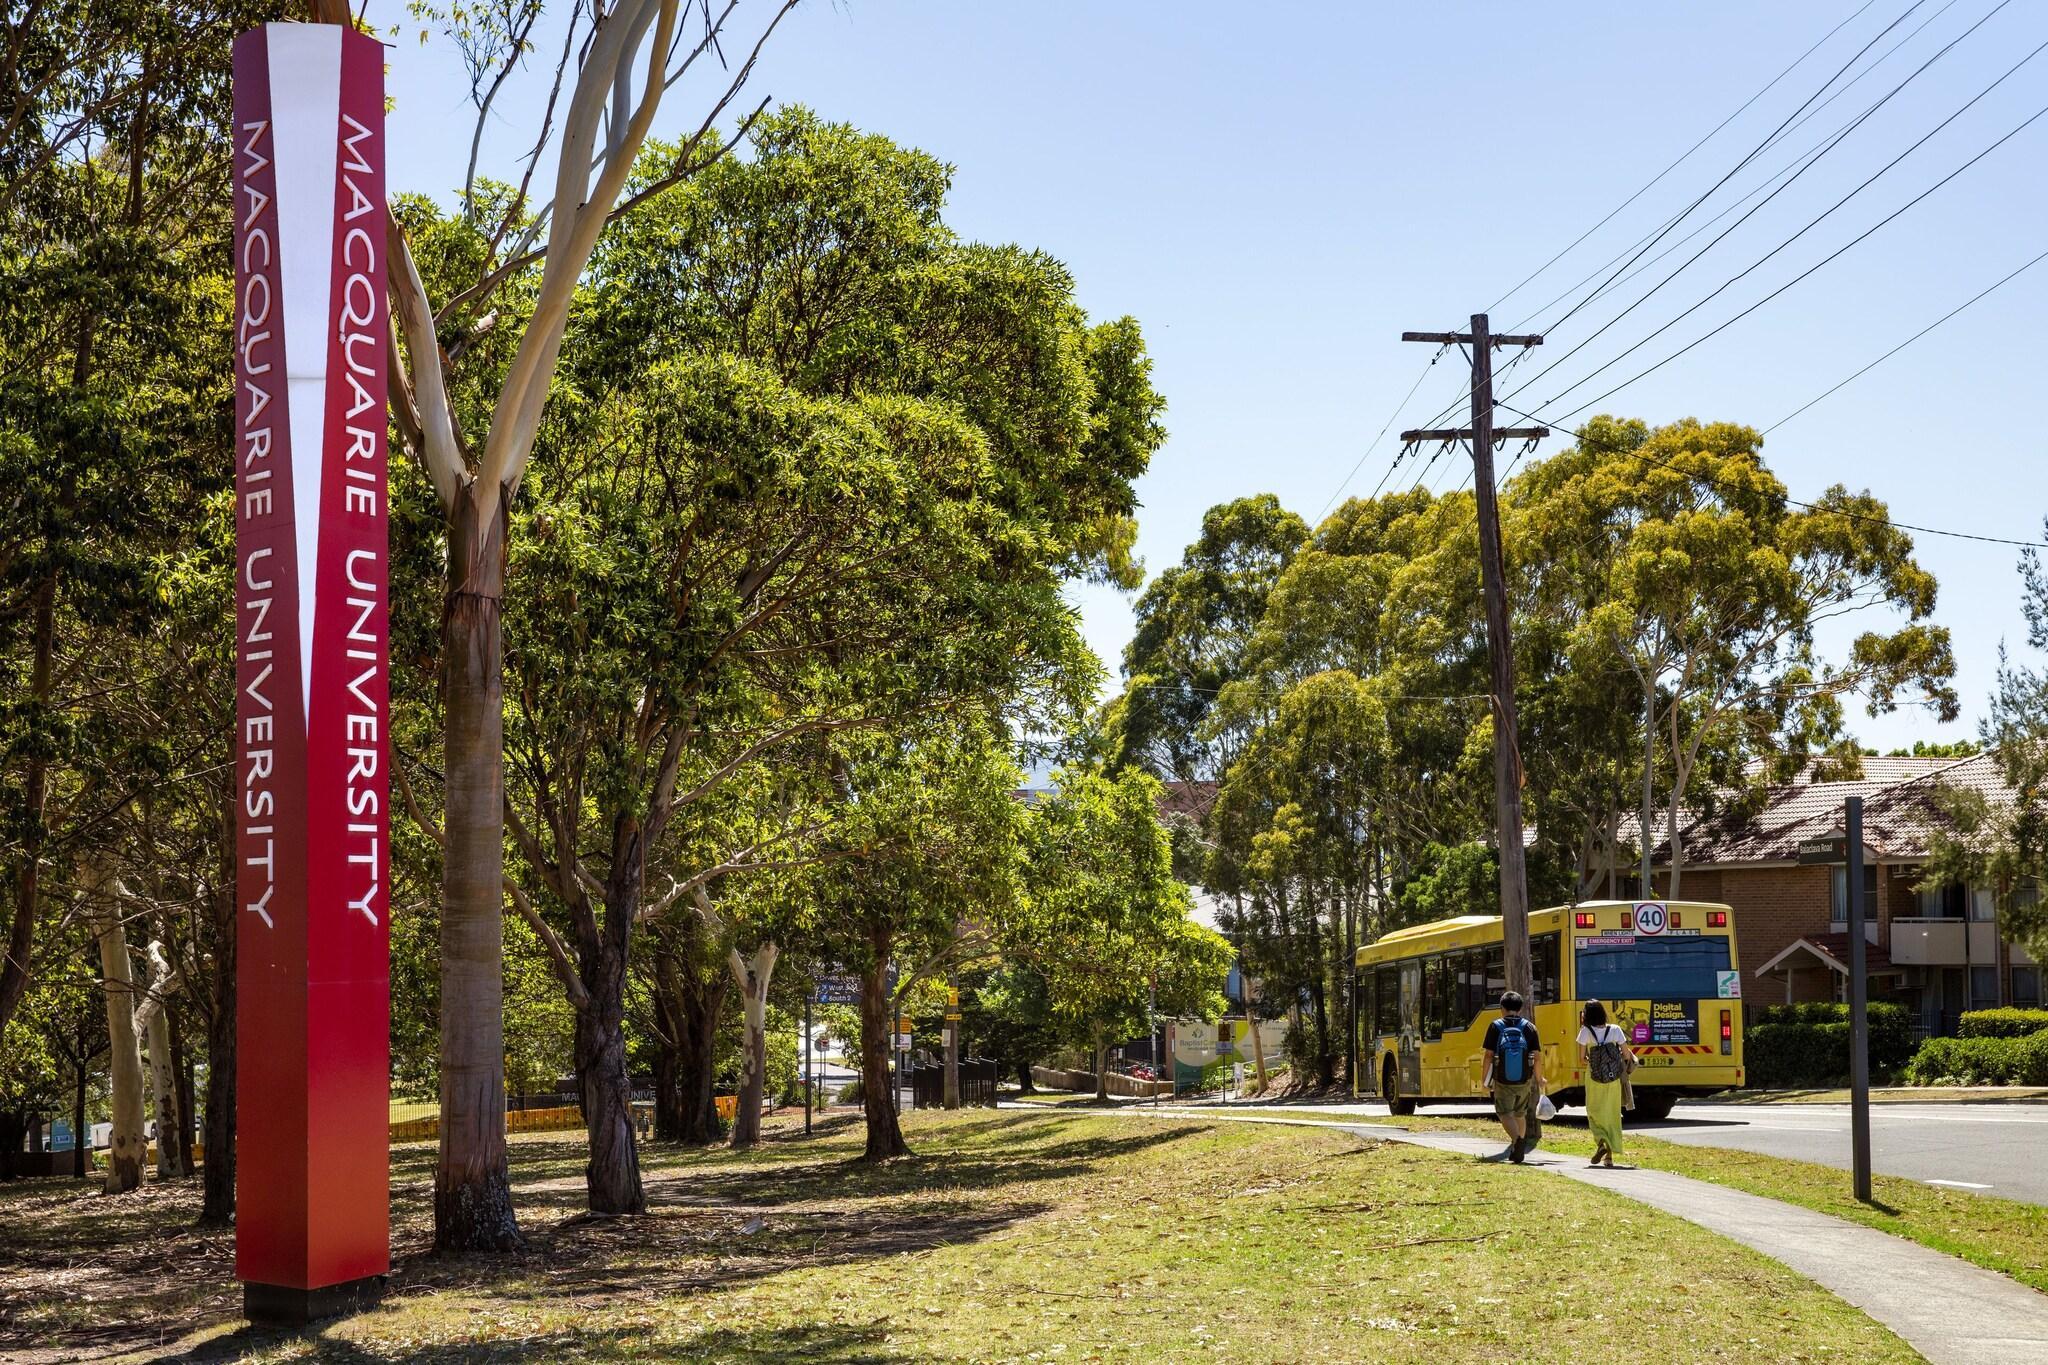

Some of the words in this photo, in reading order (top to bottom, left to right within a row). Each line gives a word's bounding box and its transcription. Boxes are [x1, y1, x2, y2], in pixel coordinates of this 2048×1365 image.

[240, 119, 272, 519] MACQUARIE
[339, 113, 376, 517] MACQUARIE
[245, 547, 274, 929] UNIVERSITY
[345, 549, 379, 927] UNIVERSITY
[1639, 910, 1663, 927] 40
[1821, 842, 1832, 852] Road
[1653, 1003, 1681, 1012] Digital
[1653, 1011, 1686, 1020] Design.
